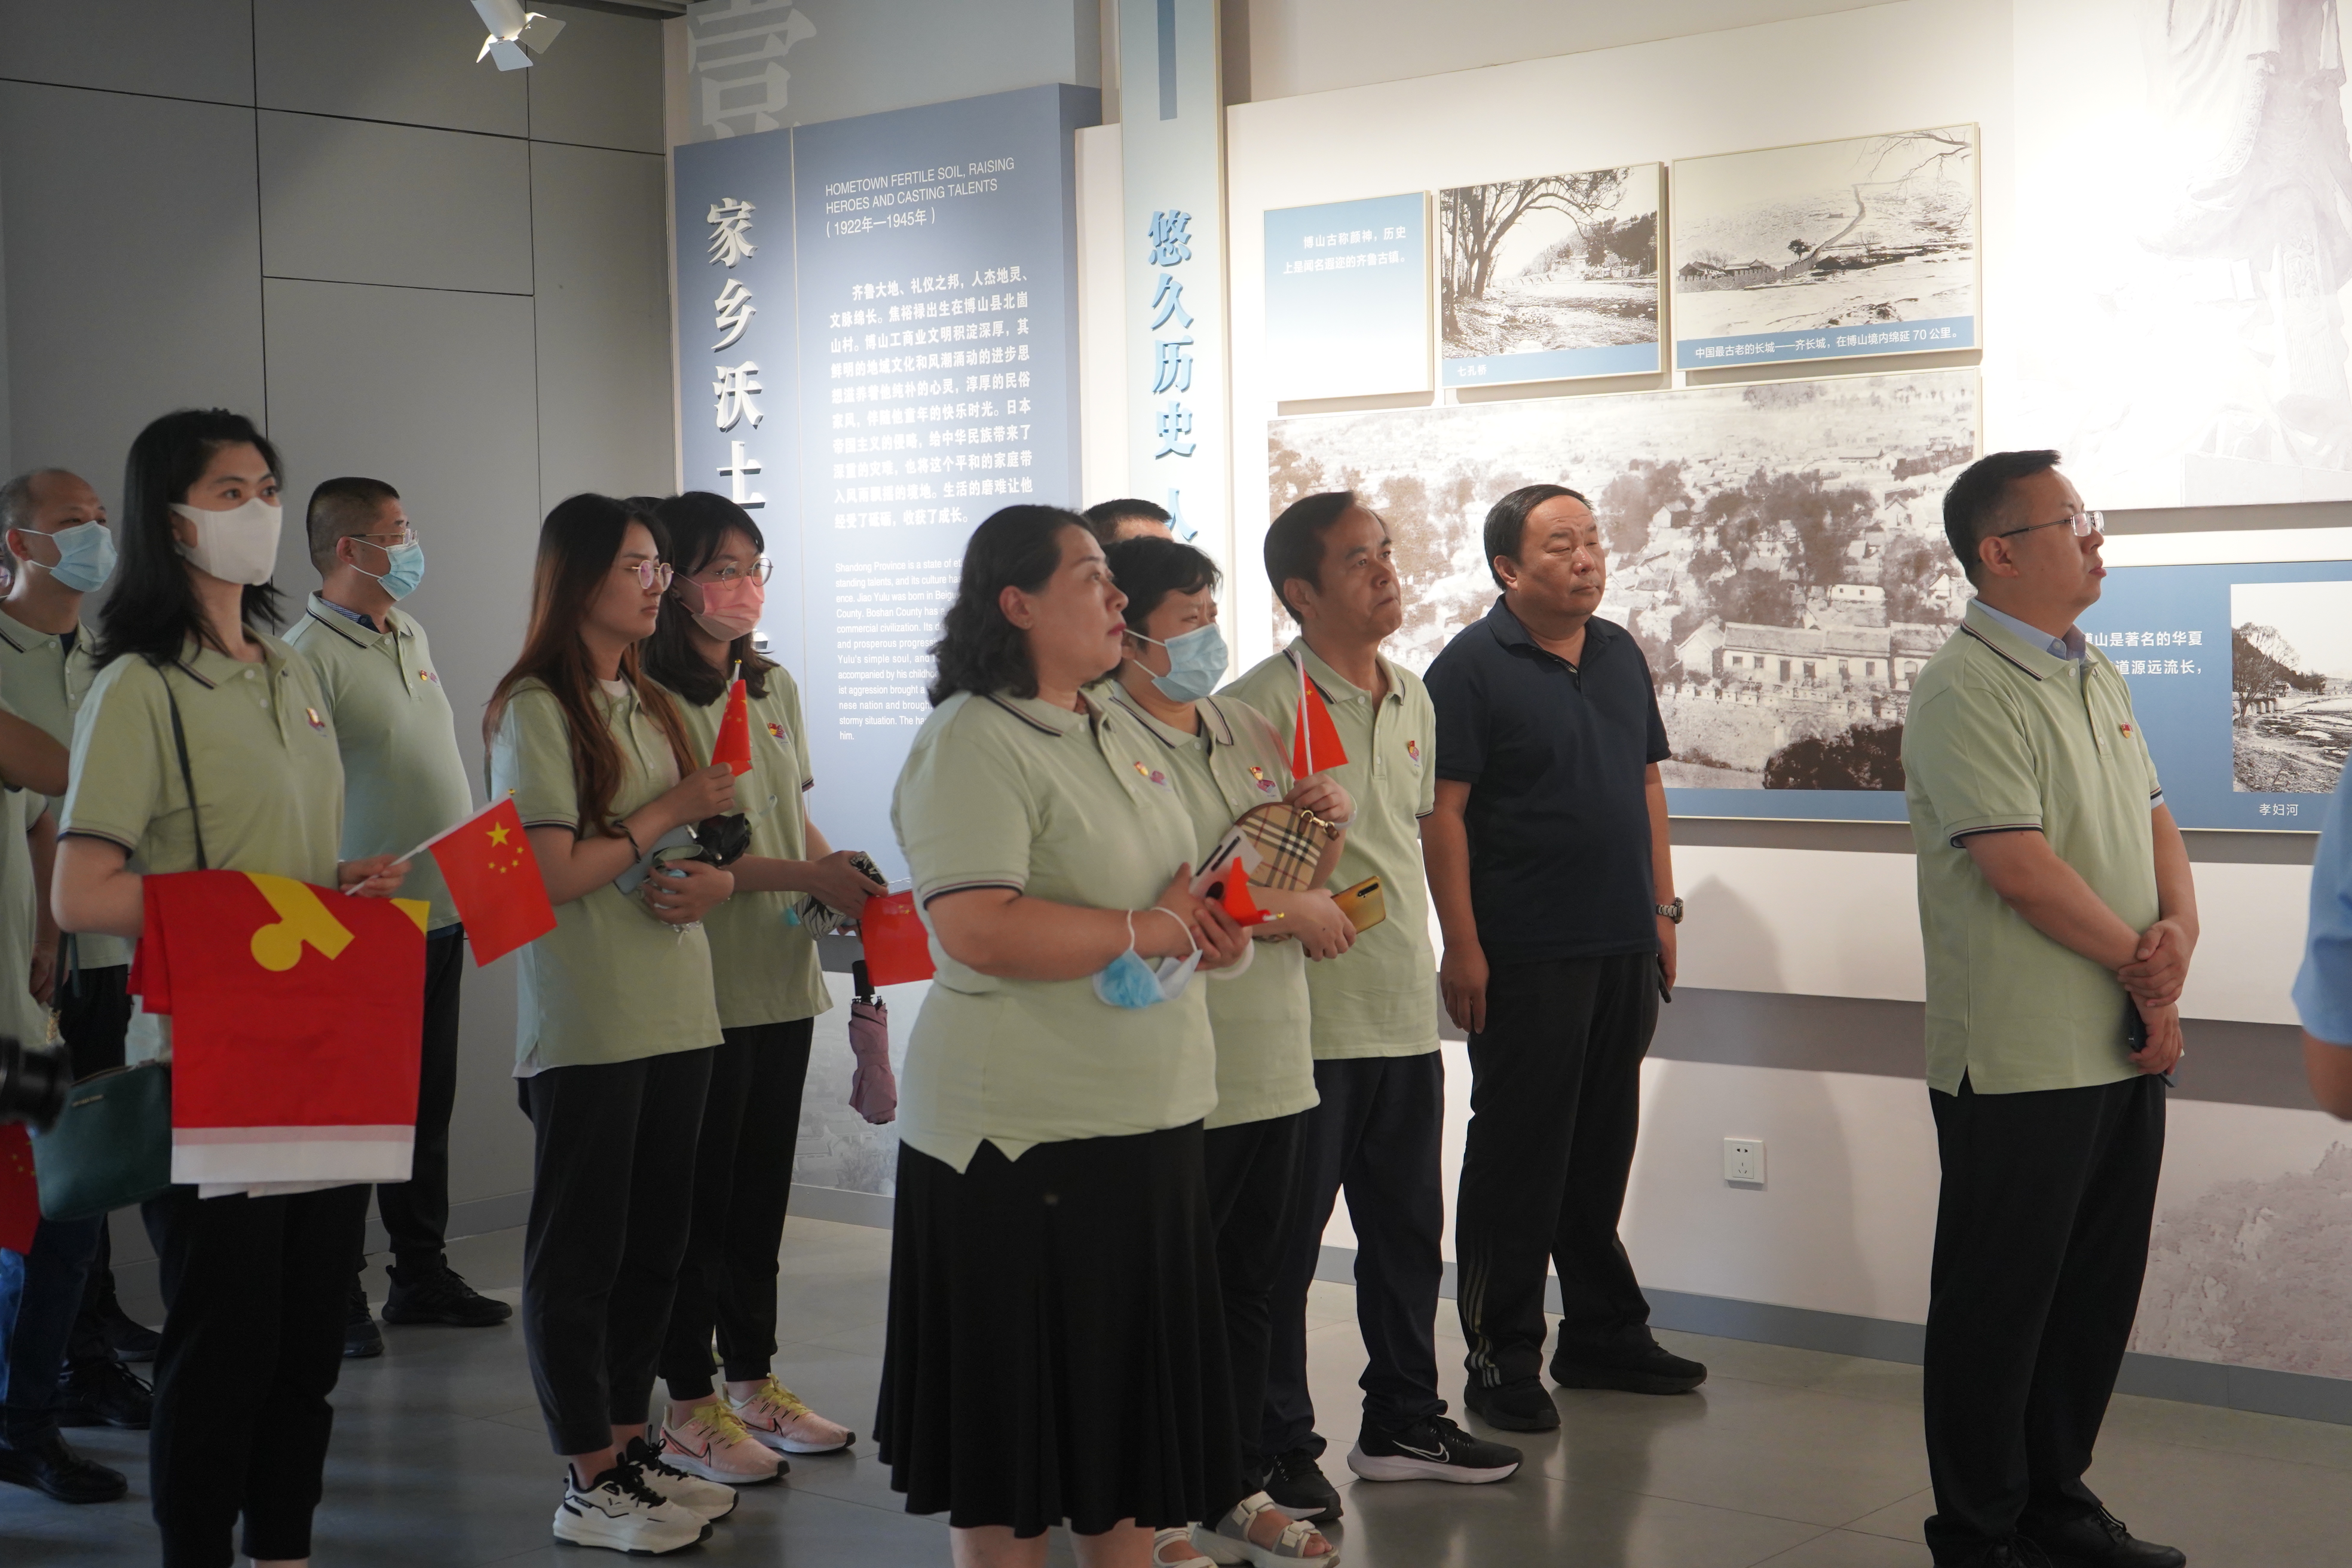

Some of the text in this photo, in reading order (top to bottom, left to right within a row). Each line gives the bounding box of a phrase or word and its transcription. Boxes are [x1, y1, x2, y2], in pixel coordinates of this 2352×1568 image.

[826, 157, 1015, 196] HOMETOWN FERTILE SOIL, RAISING
[826, 179, 998, 214] HEROES AND CASTING TALENTS
[1303, 226, 1406, 249] 博山古称颜神，历史
[1148, 209, 1196, 460] 悠久历史
[1913, 329, 1927, 341] 70
[1457, 365, 1487, 376] 七孔桥
[835, 563, 872, 573] Shandong
[874, 561, 906, 571] Province
[908, 561, 914, 569] is
[923, 560, 942, 568] state
[944, 558, 951, 568] of
[835, 578, 865, 589] standing
[868, 577, 893, 587] talents,
[896, 576, 909, 585] and
[911, 575, 920, 585] its
[921, 574, 947, 584] culture
[857, 593, 872, 602] Jiao
[874, 592, 890, 601] Yulu
[927, 590, 933, 600] in
[837, 608, 864, 619] County.
[866, 608, 893, 617] Boshan
[896, 607, 922, 618] County
[924, 607, 938, 615] has
[837, 623, 878, 633] commercial
[880, 622, 921, 632] civilization.
[924, 622, 933, 631] Its
[837, 639, 851, 648] and
[854, 640, 896, 650] prosperous
[838, 655, 861, 663] Yulu's
[864, 654, 889, 664] simple
[893, 654, 912, 664] soul,
[915, 654, 930, 663] and
[838, 670, 884, 680] accompanied
[886, 670, 895, 680] by
[896, 669, 907, 678] his
[838, 685, 847, 694] ist
[849, 685, 888, 696] aggression
[890, 685, 918, 696] brought
[859, 700, 883, 709] nation
[886, 700, 900, 709] and
[839, 716, 863, 727] stormy
[865, 716, 897, 725] situation.
[899, 716, 913, 725] The
[840, 731, 855, 740] him.
[2259, 803, 2299, 816] 孝妇河
